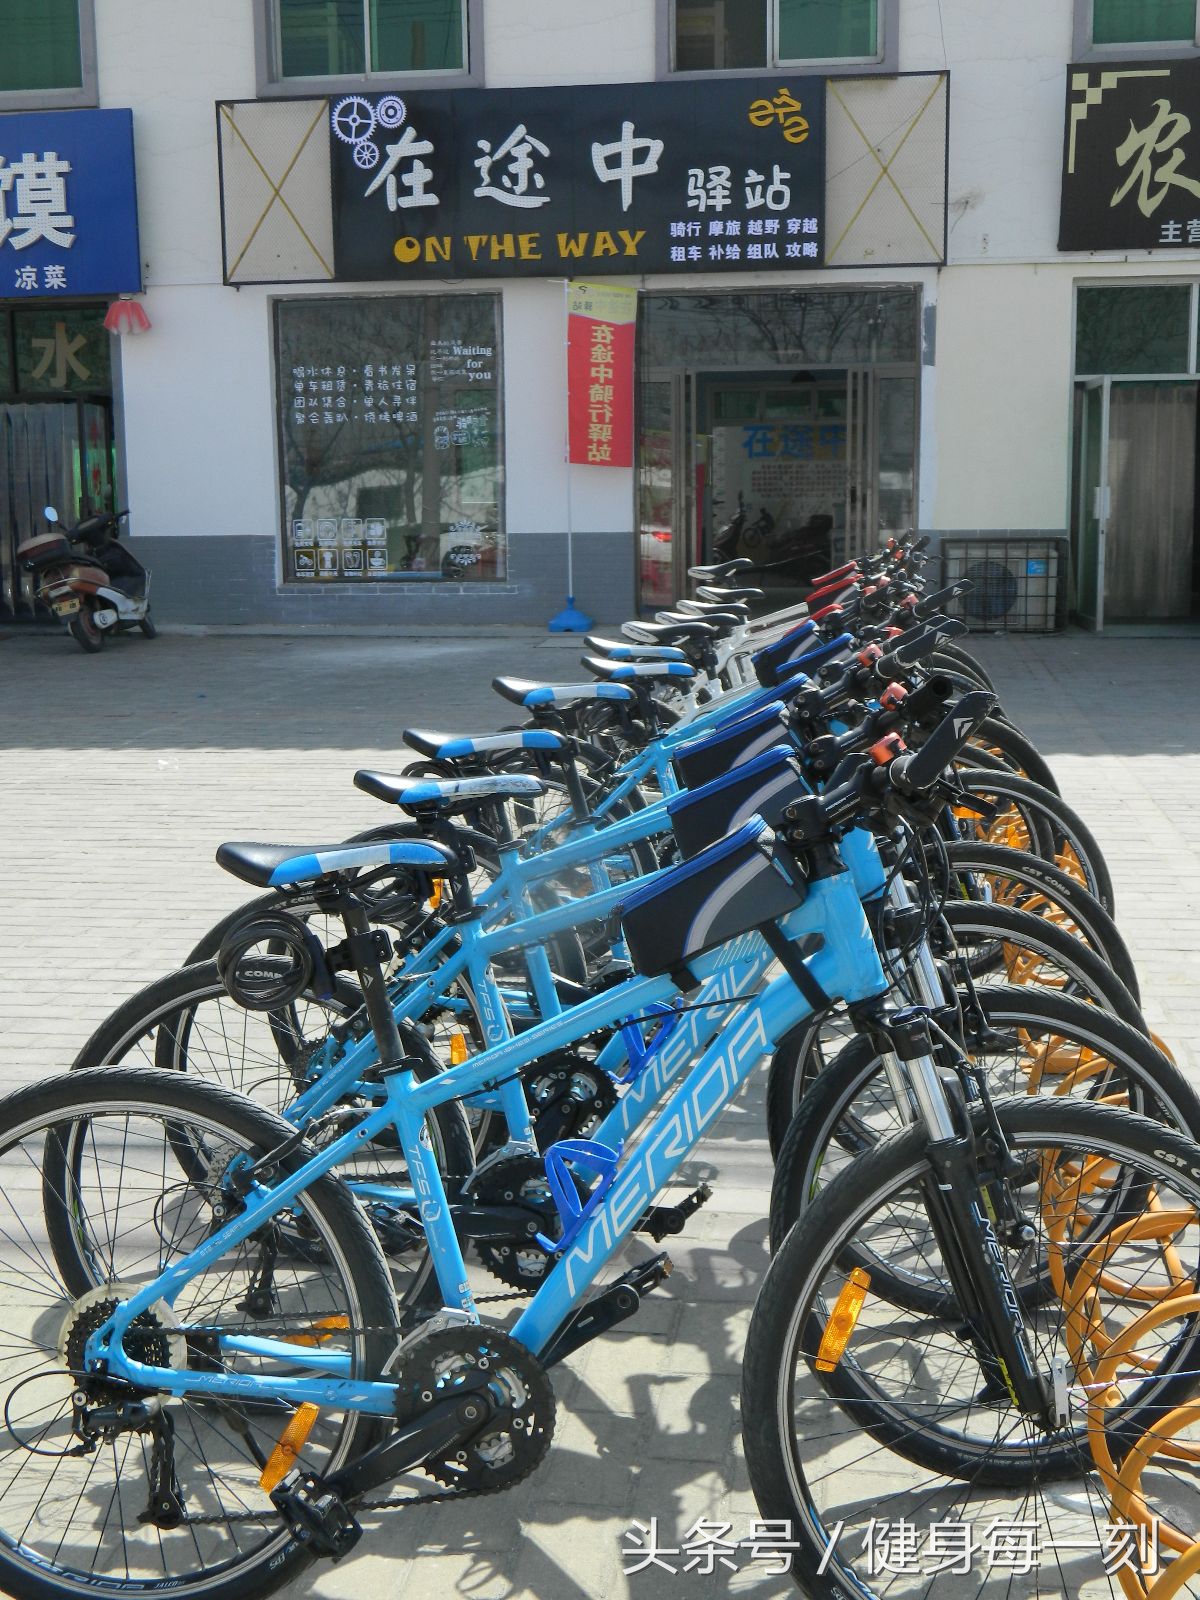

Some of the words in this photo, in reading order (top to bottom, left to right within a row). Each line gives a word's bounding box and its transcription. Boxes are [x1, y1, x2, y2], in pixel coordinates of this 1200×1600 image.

[687, 164, 791, 213] 驿站
[670, 222, 702, 238] 骑行
[708, 220, 742, 236] 摩旅
[747, 218, 780, 235] 越野
[786, 217, 819, 234] 穿越
[394, 235, 452, 263] ON
[464, 232, 542, 261] THE
[557, 229, 647, 259] WAY
[670, 245, 702, 262] 租车
[708, 243, 742, 260] 补给
[747, 243, 779, 260] 组队
[786, 241, 818, 258] 攻略
[14, 264, 68, 290] 凉菜
[31, 322, 92, 388] 水
[453, 346, 492, 357] Waiting
[467, 359, 484, 369] for
[468, 371, 492, 381] you
[565, 1007, 767, 1298] MERIDA
[1153, 1149, 1188, 1167] CST
[408, 1144, 431, 1196] TFS
[975, 1202, 1025, 1336] MERIDA
